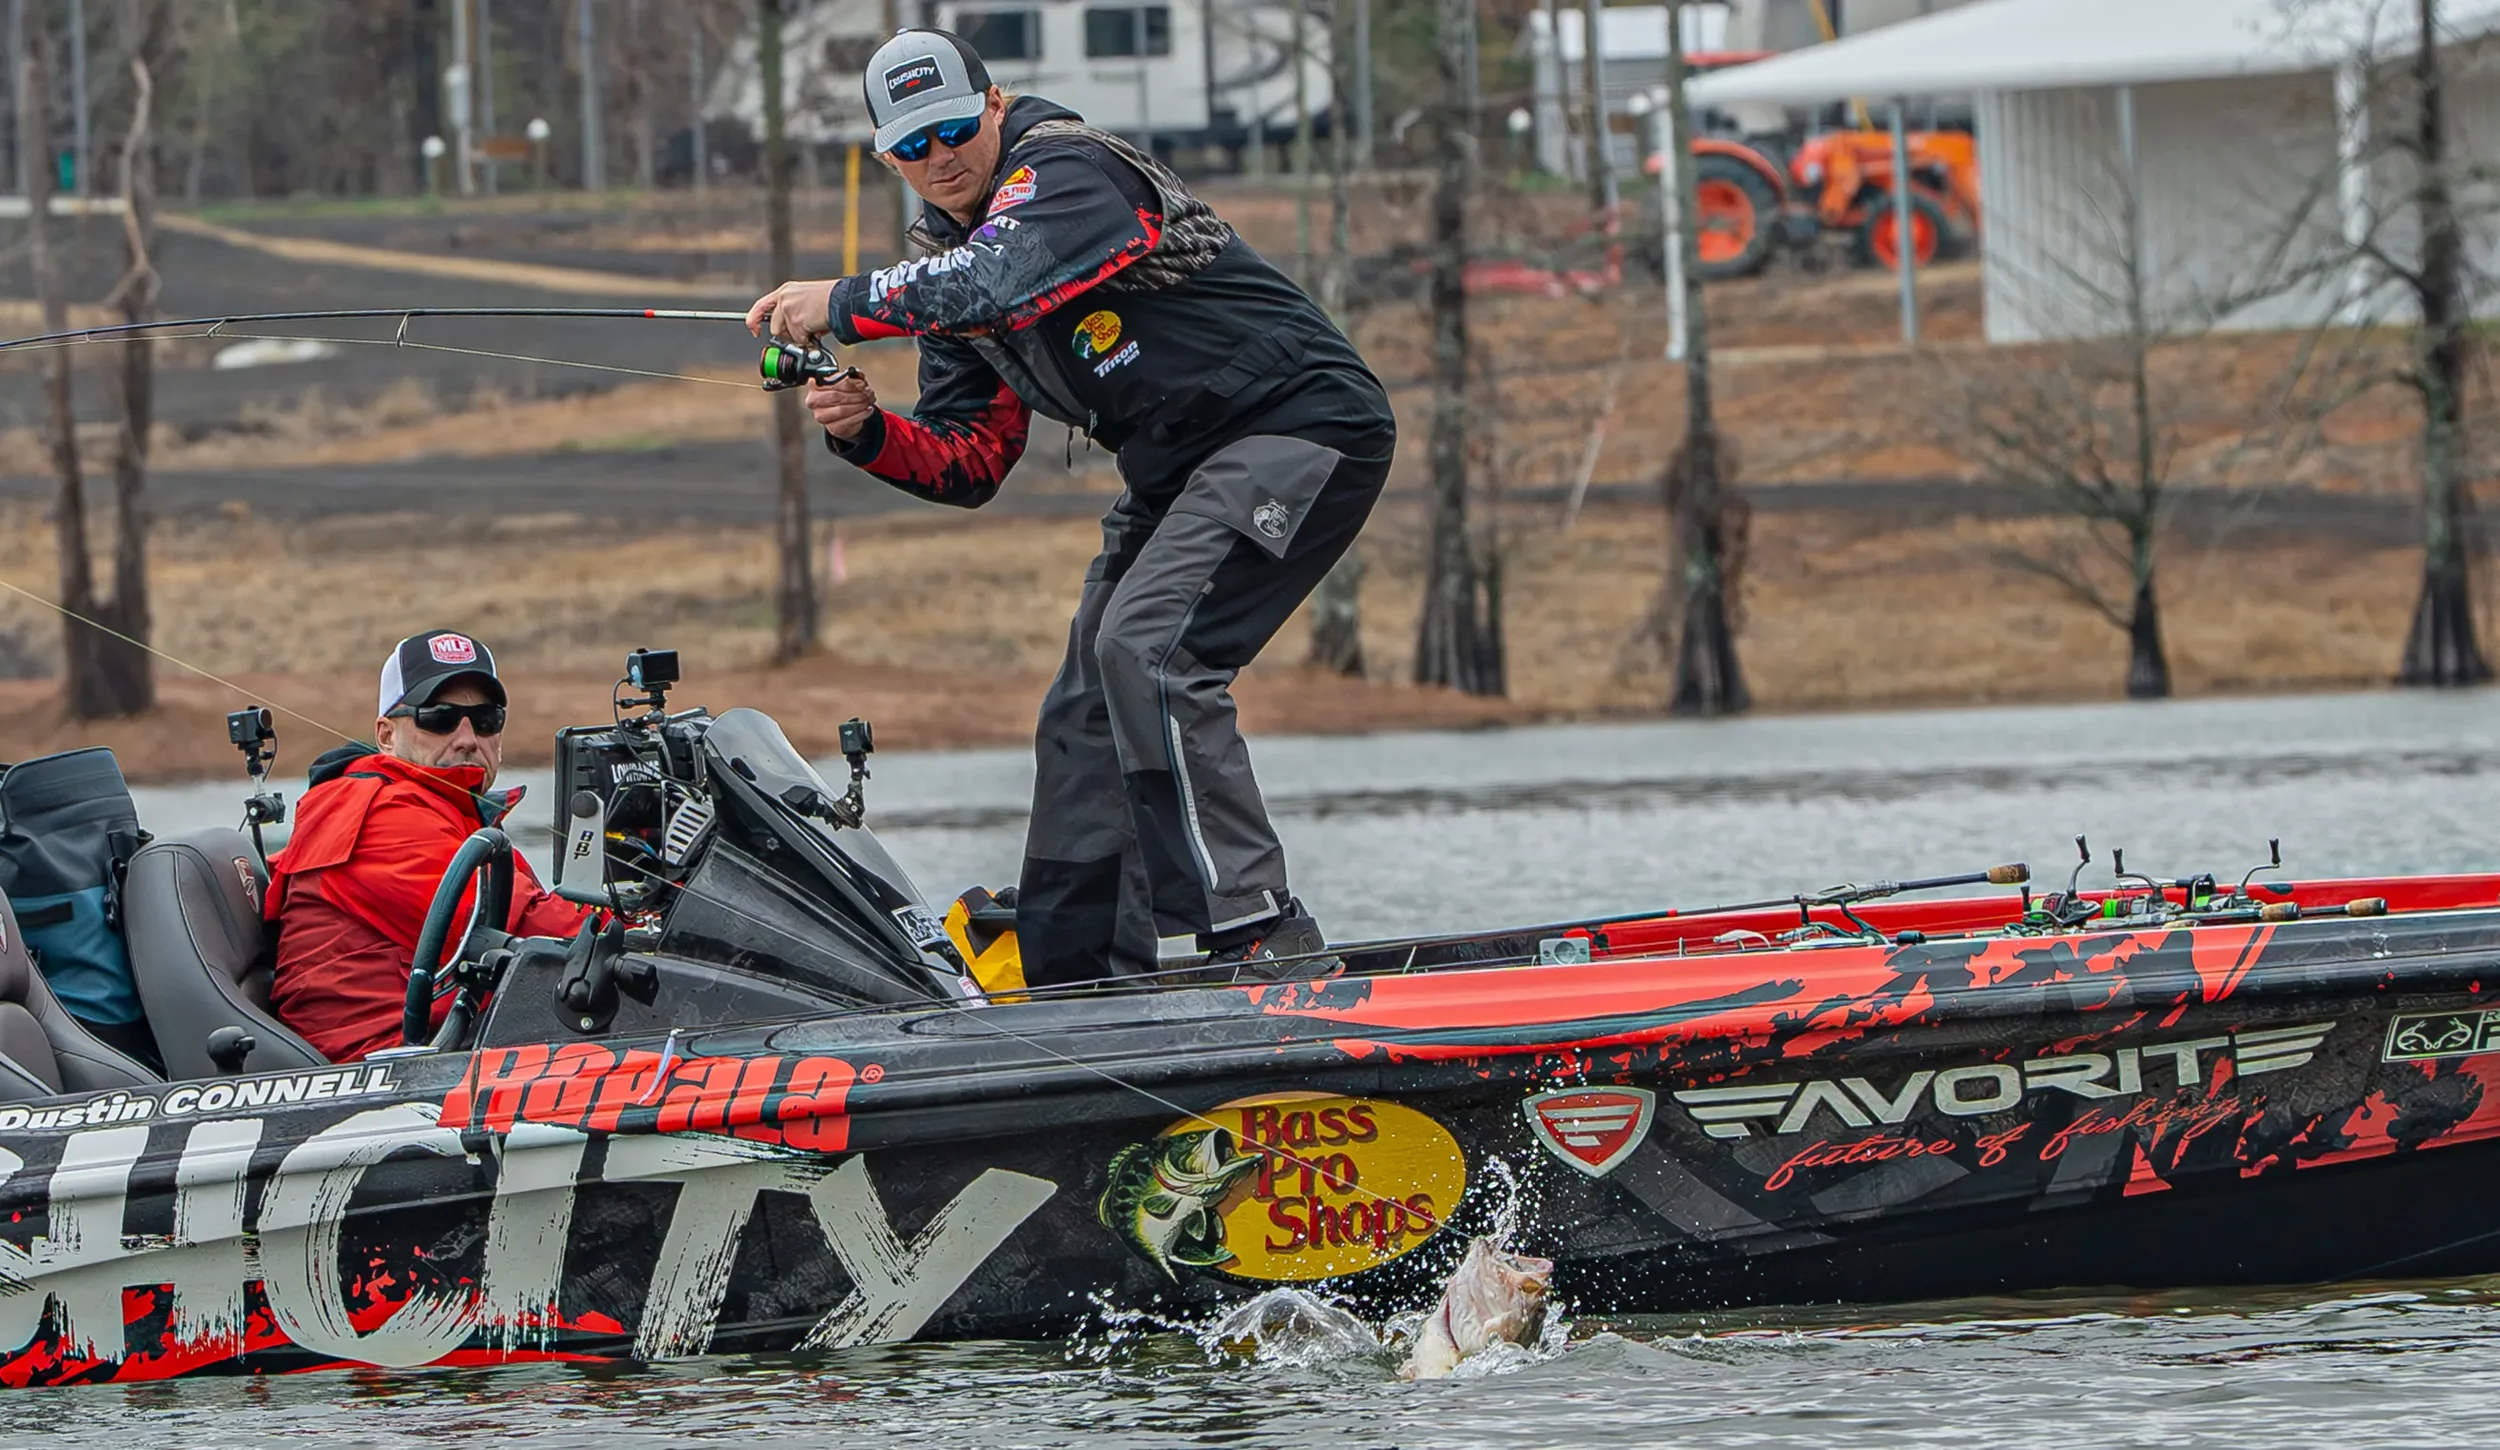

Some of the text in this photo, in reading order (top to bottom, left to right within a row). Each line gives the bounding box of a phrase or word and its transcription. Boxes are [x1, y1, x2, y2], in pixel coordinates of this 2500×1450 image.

[1093, 340, 1139, 378] Triton
[437, 638, 470, 653] MLF
[0, 1068, 397, 1130] Dustin CONNELL
[1238, 1104, 1379, 1151] Bass
[1764, 1096, 2242, 1192] future of fishing
[1252, 1148, 1359, 1204] Pro
[1265, 1193, 1440, 1256] Shops
